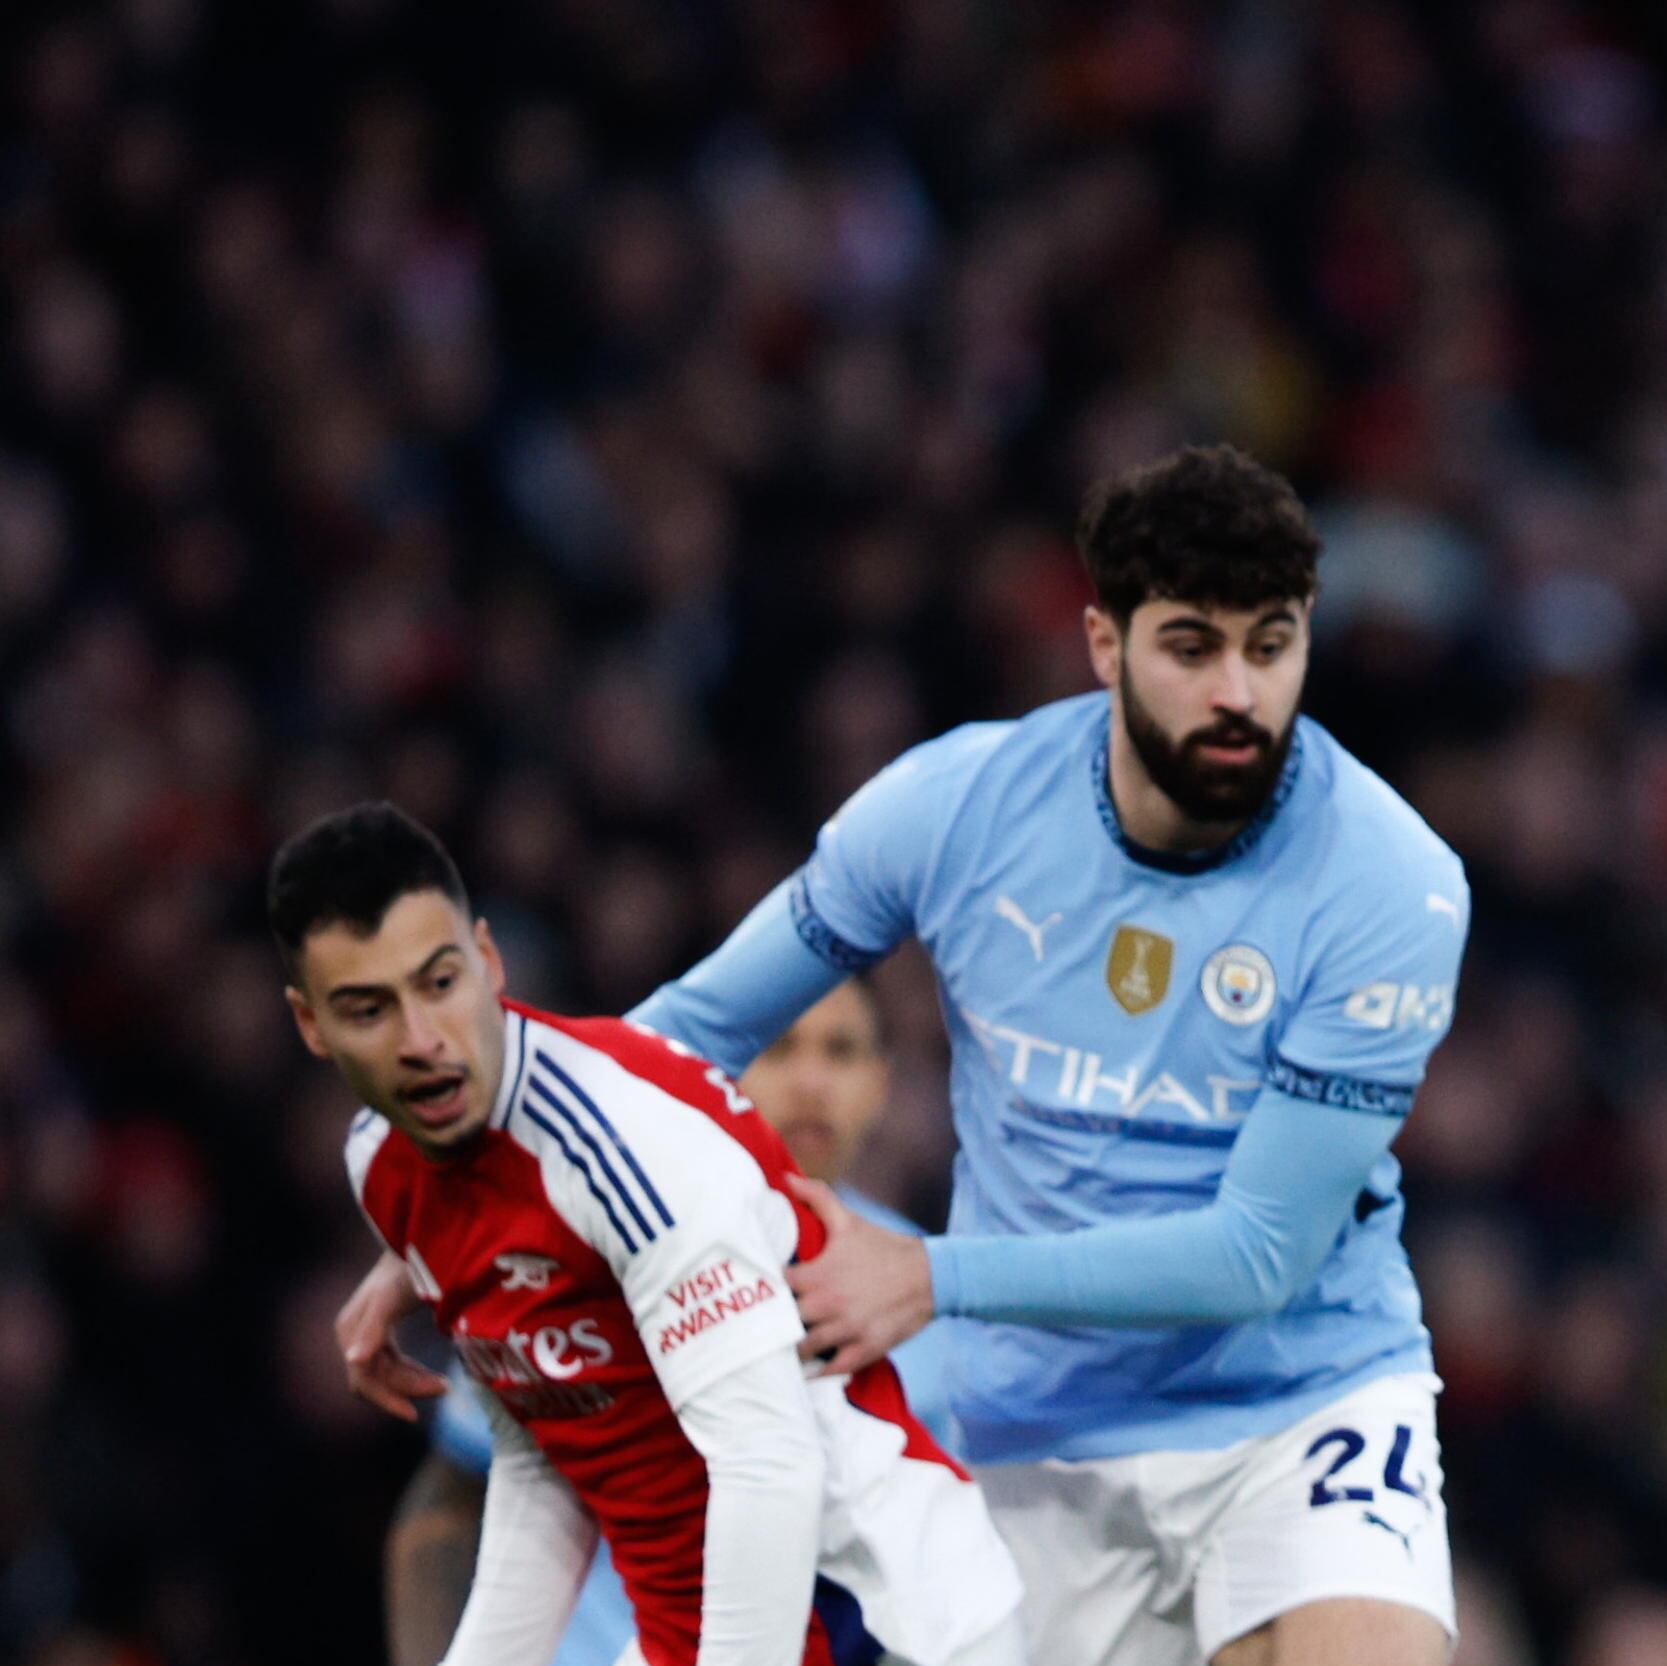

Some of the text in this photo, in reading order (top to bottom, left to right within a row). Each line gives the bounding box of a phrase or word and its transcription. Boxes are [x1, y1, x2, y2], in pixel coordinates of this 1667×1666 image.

[660, 1277, 776, 1354] RWANDA
[664, 1258, 735, 1308] VISIT
[1304, 1424, 1432, 1507] 24
